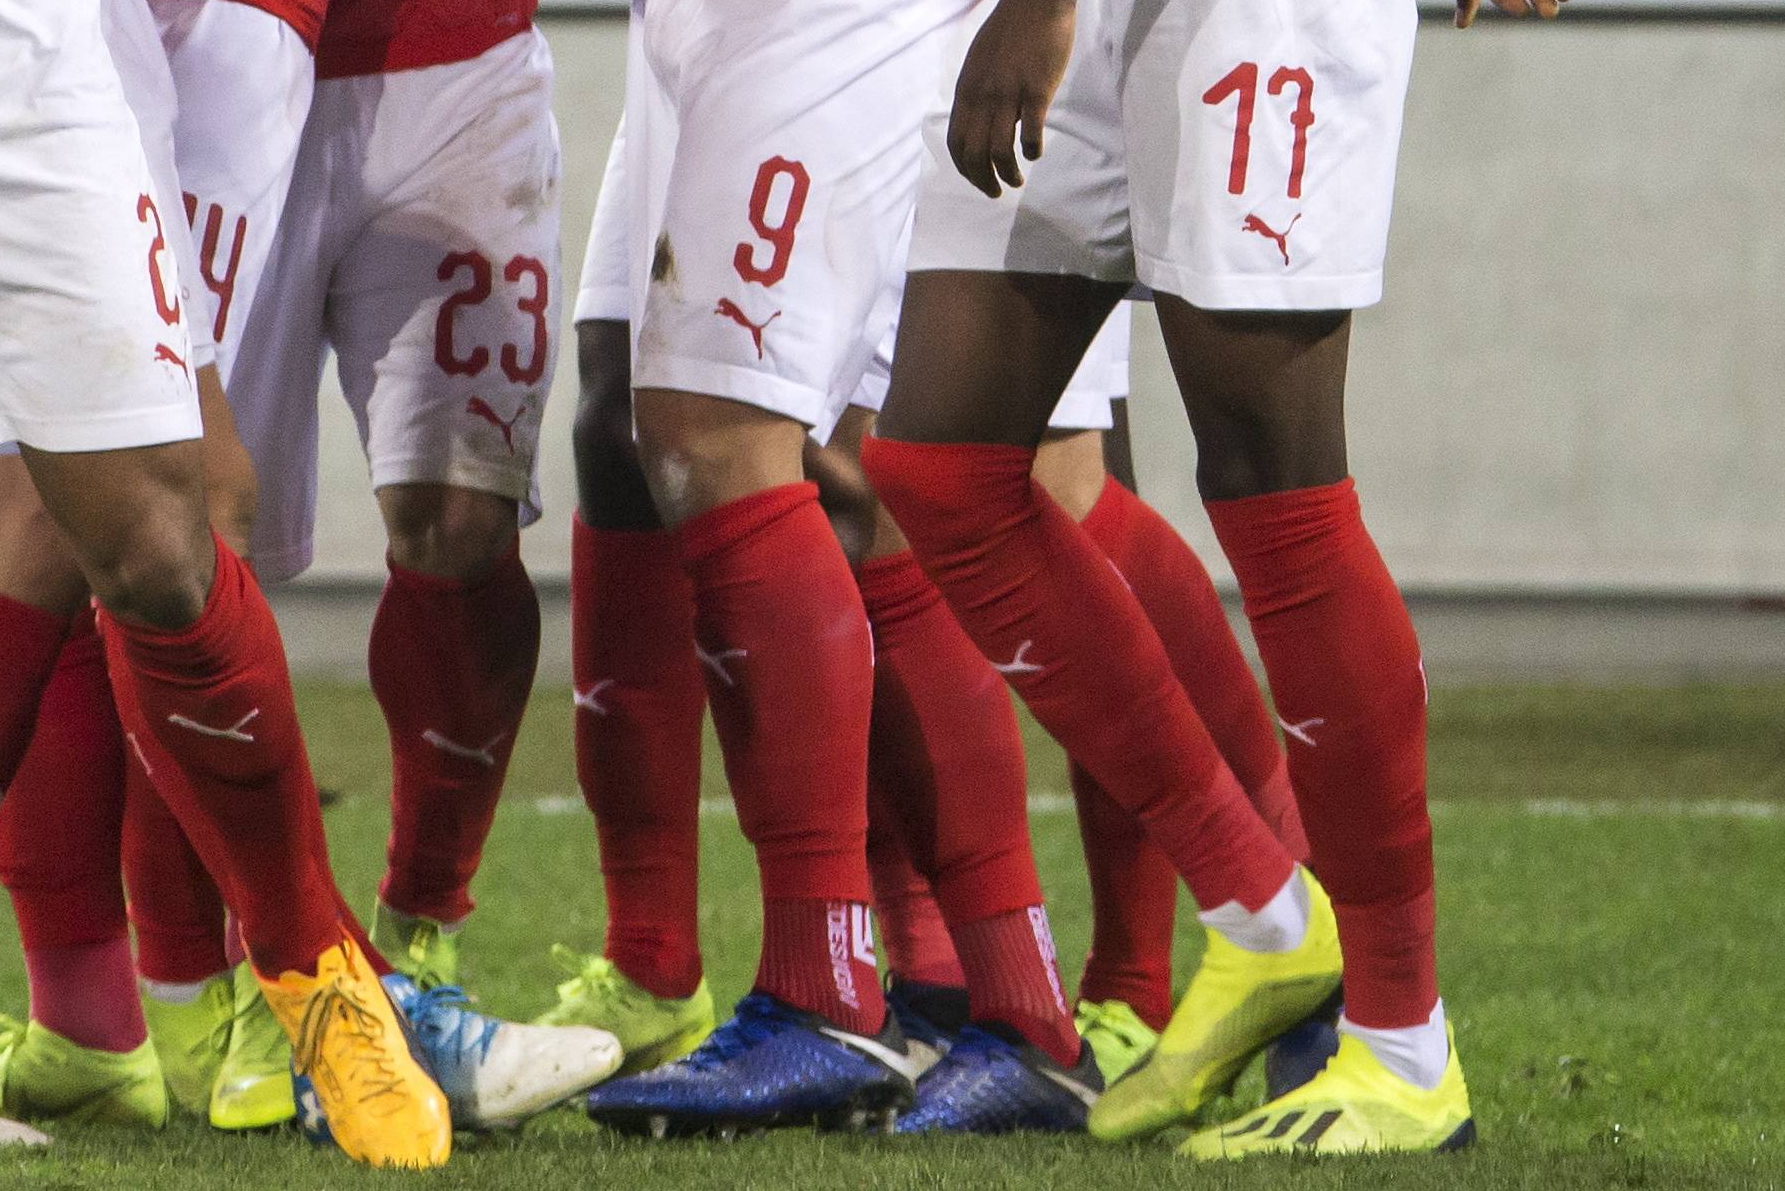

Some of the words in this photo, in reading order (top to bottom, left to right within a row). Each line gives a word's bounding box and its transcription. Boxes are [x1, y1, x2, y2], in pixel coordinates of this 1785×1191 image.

[1202, 62, 1315, 199] 17
[137, 193, 180, 326] 2
[733, 155, 810, 288] 9
[434, 251, 548, 385] 23
